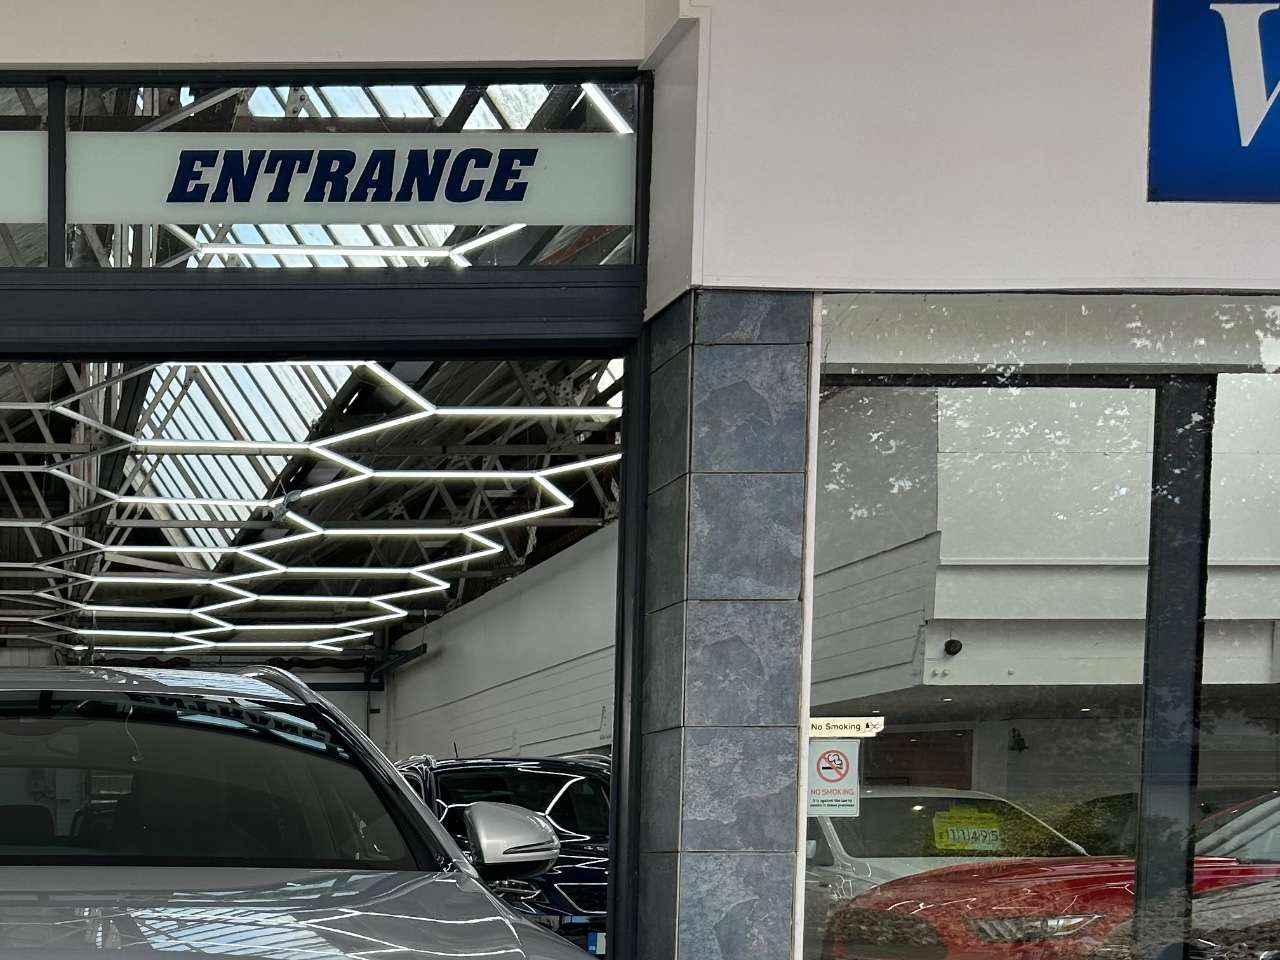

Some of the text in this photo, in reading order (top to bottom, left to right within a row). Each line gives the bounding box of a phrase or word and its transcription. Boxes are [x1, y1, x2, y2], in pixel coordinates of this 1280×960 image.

[166, 148, 538, 203] ENTRANCE
[825, 722, 861, 731] Smoking
[811, 788, 854, 796] NO SMOKING
